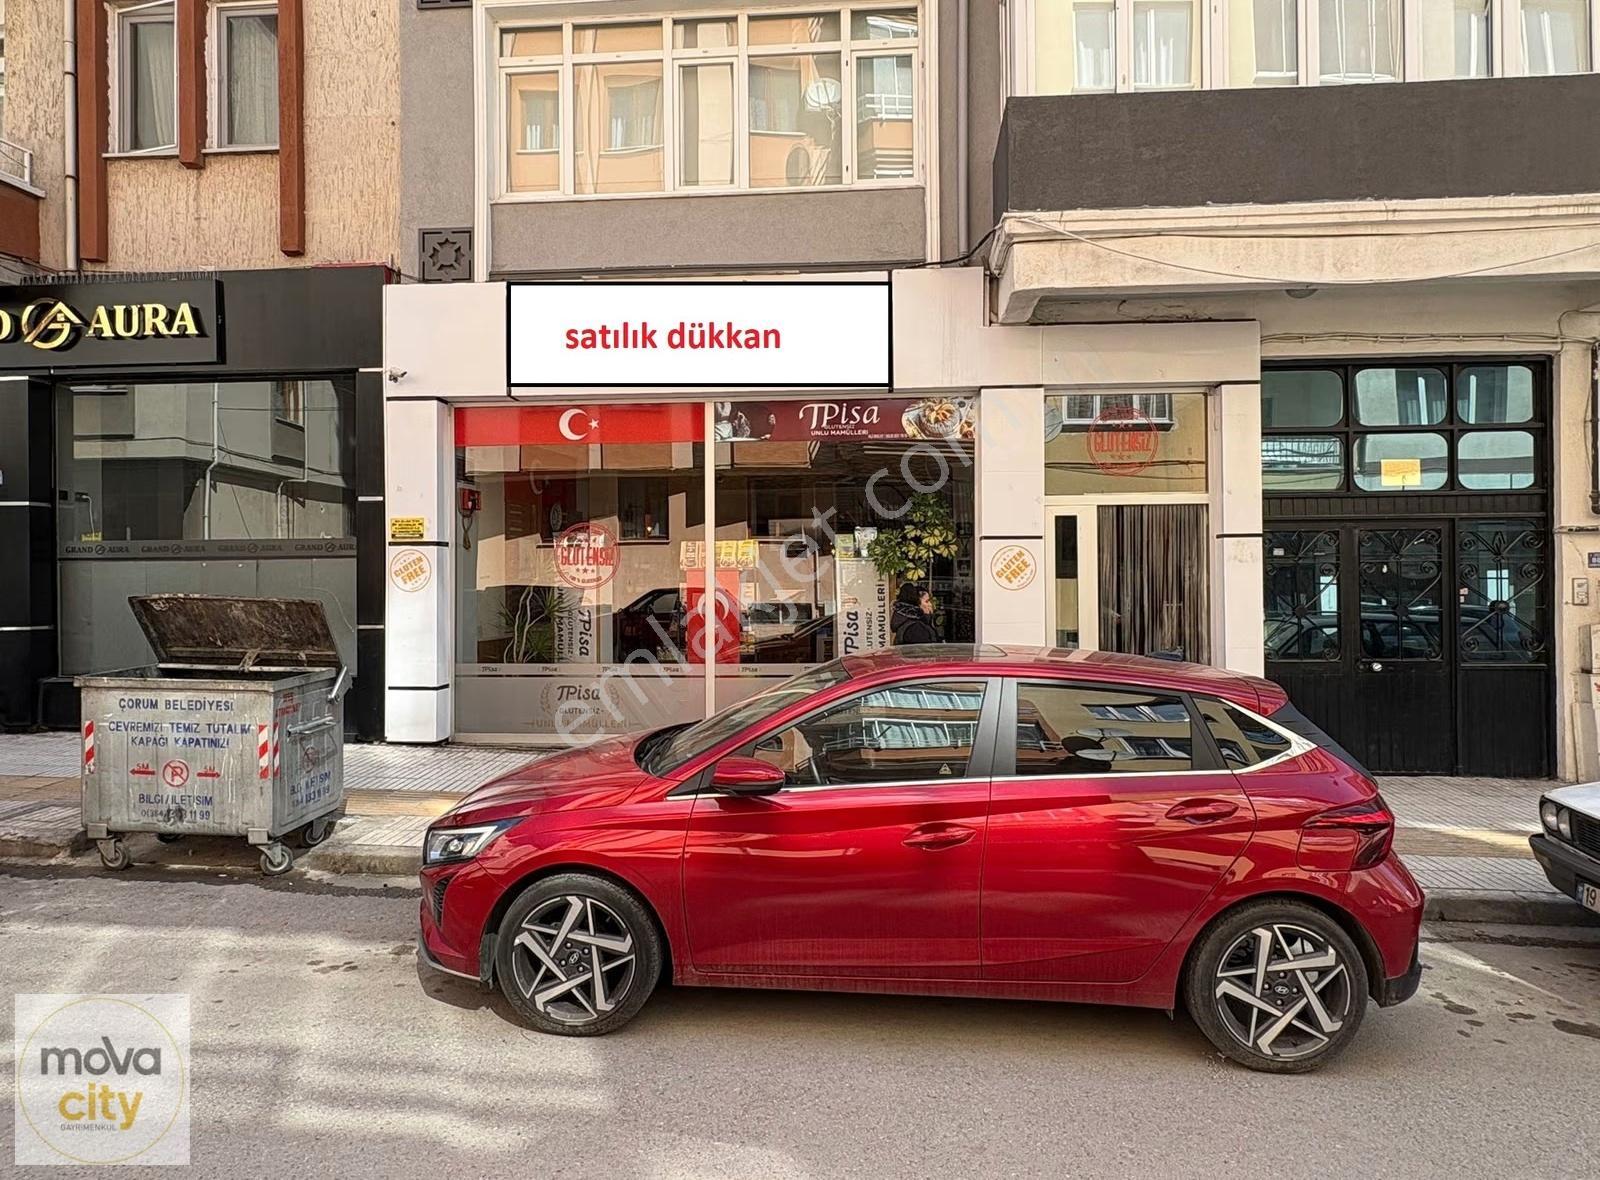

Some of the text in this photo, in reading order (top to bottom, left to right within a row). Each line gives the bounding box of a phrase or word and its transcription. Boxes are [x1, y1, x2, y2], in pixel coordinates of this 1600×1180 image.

[85, 302, 199, 337] AURA
[401, 565, 426, 584] FREE
[995, 550, 1025, 578] GLUTEN
[1004, 559, 1030, 584] FREE
[118, 698, 158, 712] ÇORUM
[1586, 886, 1597, 907] 19
